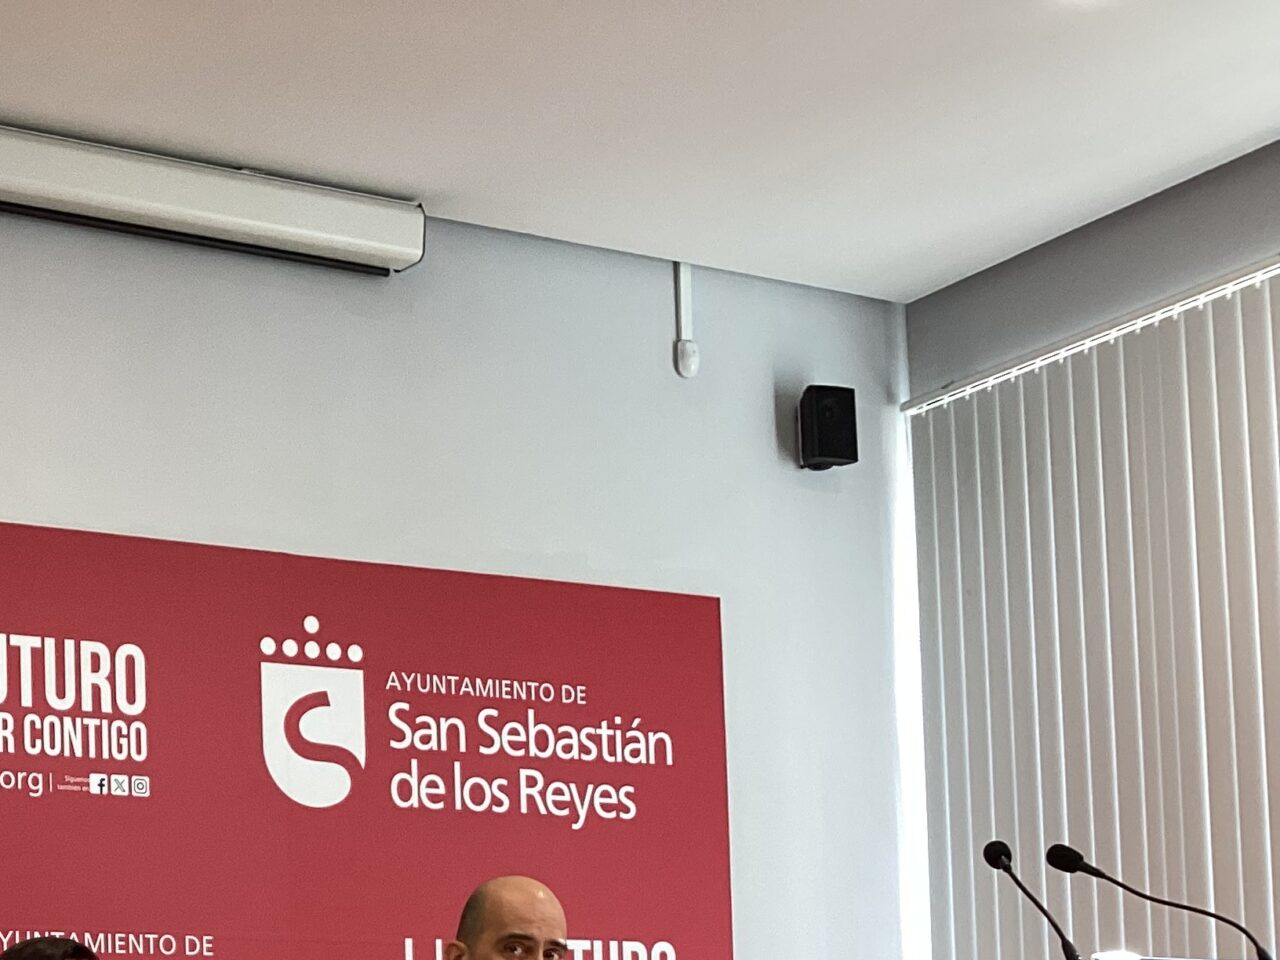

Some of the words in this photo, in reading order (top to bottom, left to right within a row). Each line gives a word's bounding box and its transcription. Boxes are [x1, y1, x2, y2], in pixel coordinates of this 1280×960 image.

[386, 671, 554, 703] AYUNTAMIENTO
[562, 684, 587, 704] DE
[24, 713, 148, 762] CONTIGO
[389, 702, 466, 752] San
[478, 708, 673, 765] Sebastián
[391, 759, 444, 810] de
[454, 762, 509, 813] los
[520, 769, 637, 830] Reyes
[184, 935, 214, 956] DE
